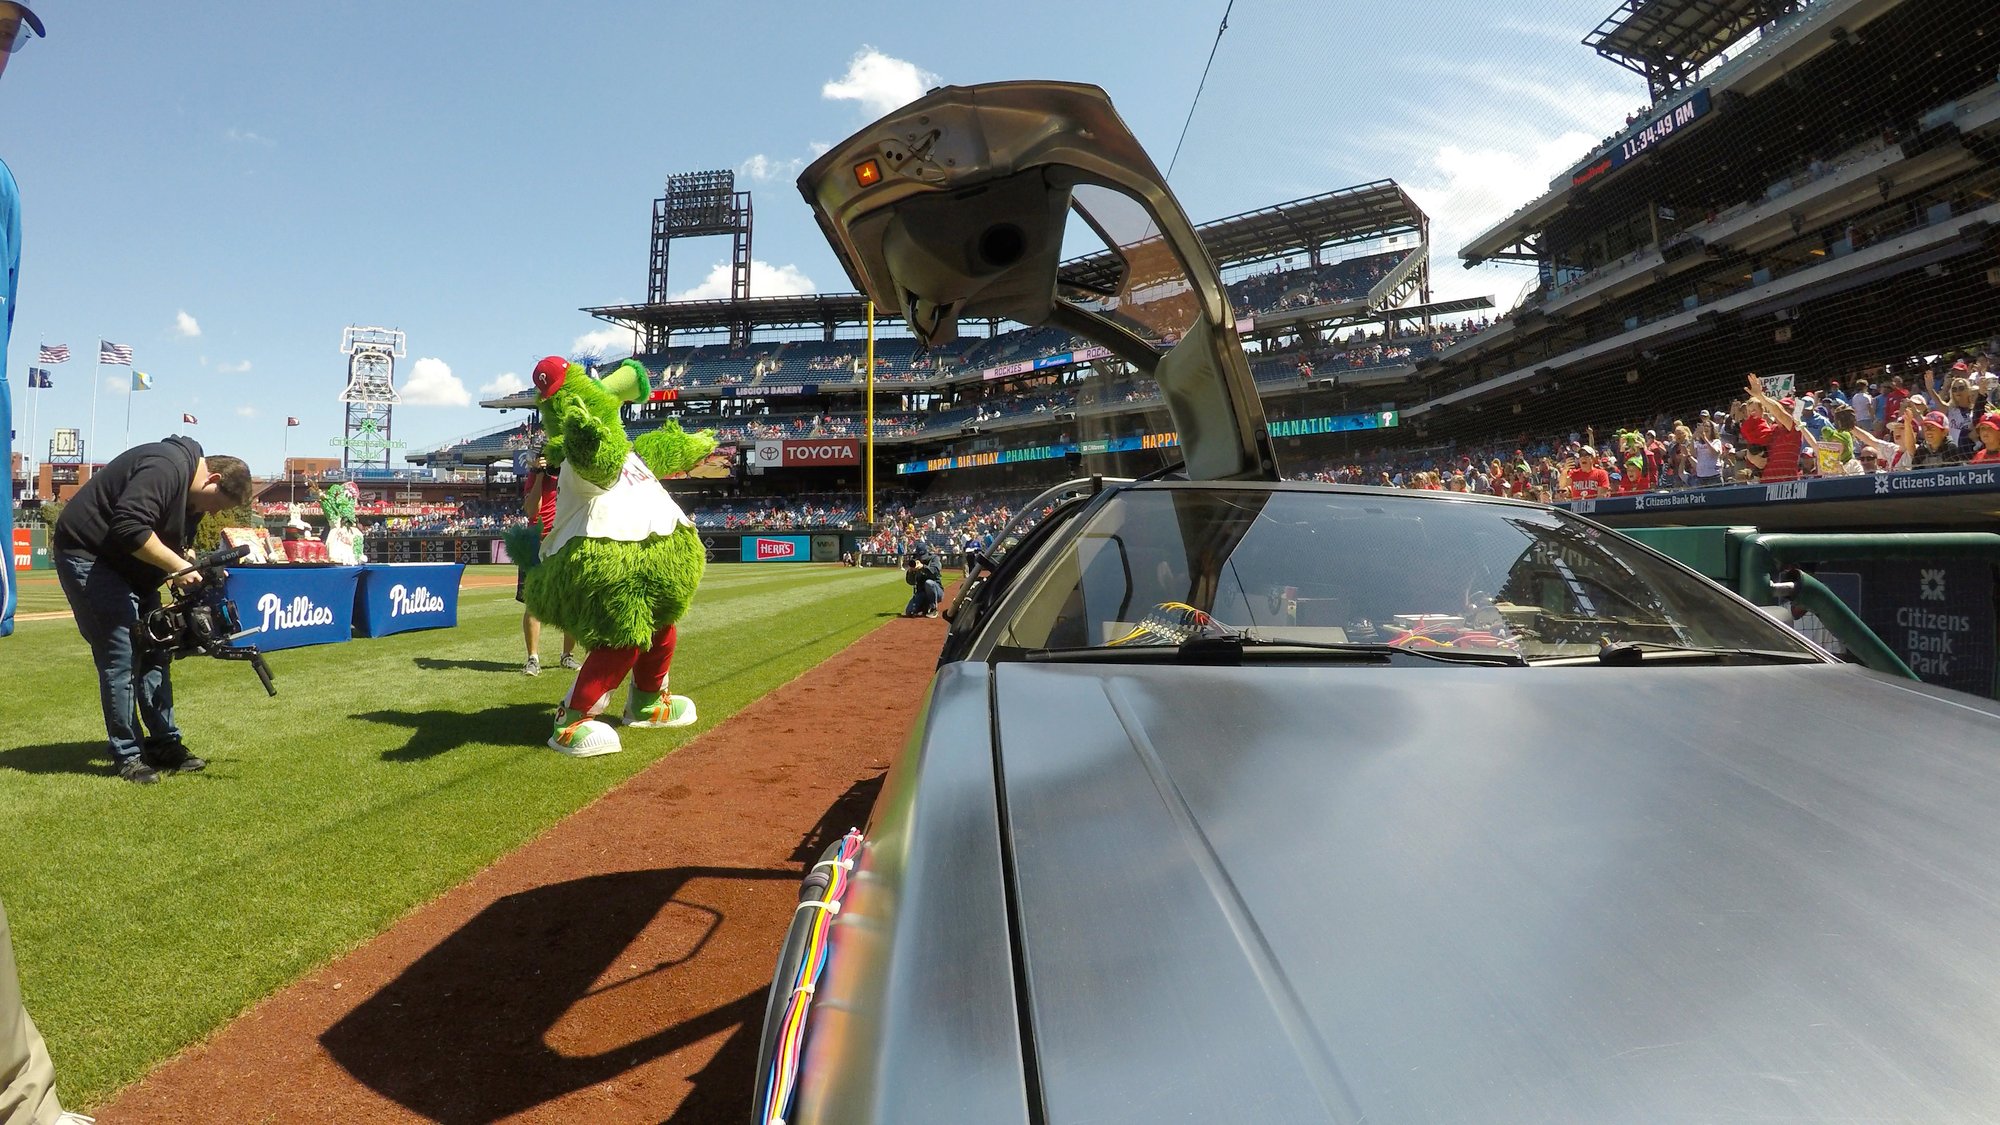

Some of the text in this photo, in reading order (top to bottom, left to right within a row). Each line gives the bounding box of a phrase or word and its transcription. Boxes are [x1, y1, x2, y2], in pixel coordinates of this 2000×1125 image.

[1622, 101, 1695, 160] 11:34:49 AM
[538, 373, 547, 385] P
[994, 364, 1022, 376] ROCKIES
[736, 385, 804, 396] LISCIO'S BAKERY
[1142, 431, 1179, 449] HAPPY
[787, 445, 854, 460] TOYOTA
[927, 457, 952, 472] HAPPY
[957, 451, 1000, 468] BIRTHDAY
[1006, 445, 1052, 462] PHANATIC
[1573, 480, 1599, 491] PHILLIES
[1892, 469, 1996, 490] Citizens Bank Park
[1645, 493, 1707, 508] Citizens Bank Park
[1765, 482, 1809, 501] PHILLIES.COM
[760, 543, 791, 555] HERR'S
[389, 584, 446, 618] Phillies
[257, 592, 334, 633] Phillies
[1896, 606, 1970, 632] Citizens
[1907, 629, 1953, 654] Bank
[1909, 651, 1950, 676] Park
